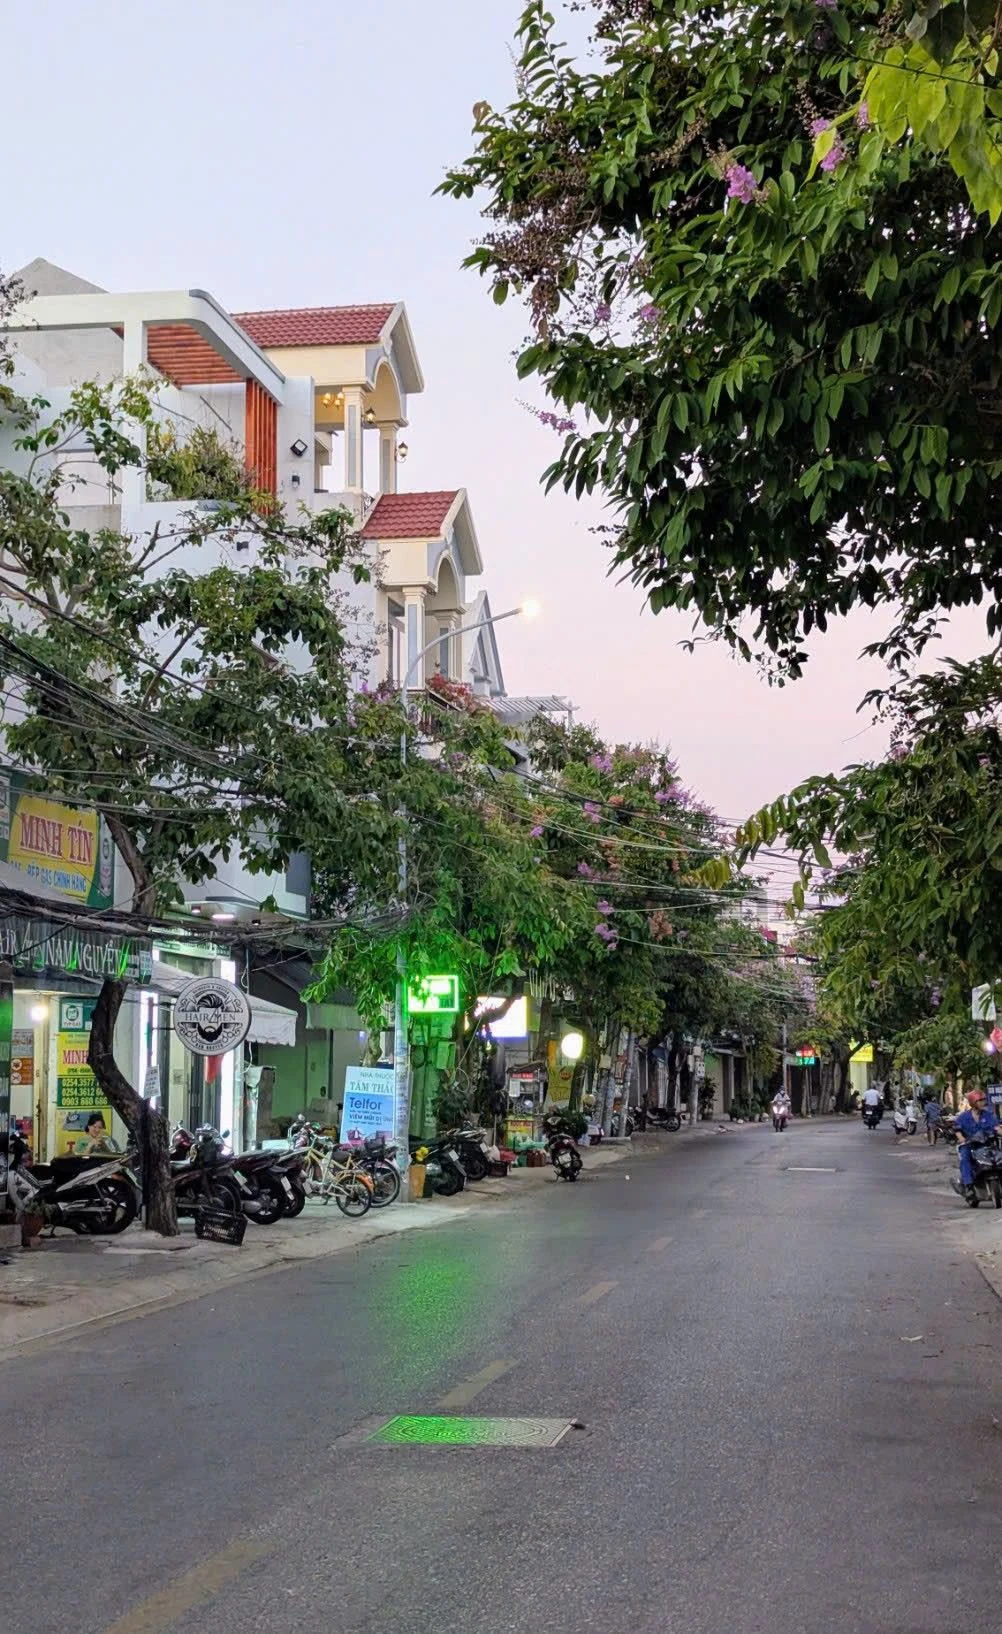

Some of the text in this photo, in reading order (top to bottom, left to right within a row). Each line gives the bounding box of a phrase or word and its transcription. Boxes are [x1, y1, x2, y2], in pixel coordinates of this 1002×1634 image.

[20, 812, 63, 857] MINH
[68, 820, 94, 865] TÍN
[46, 937, 73, 967] NAM
[349, 1097, 383, 1110] Telfor
